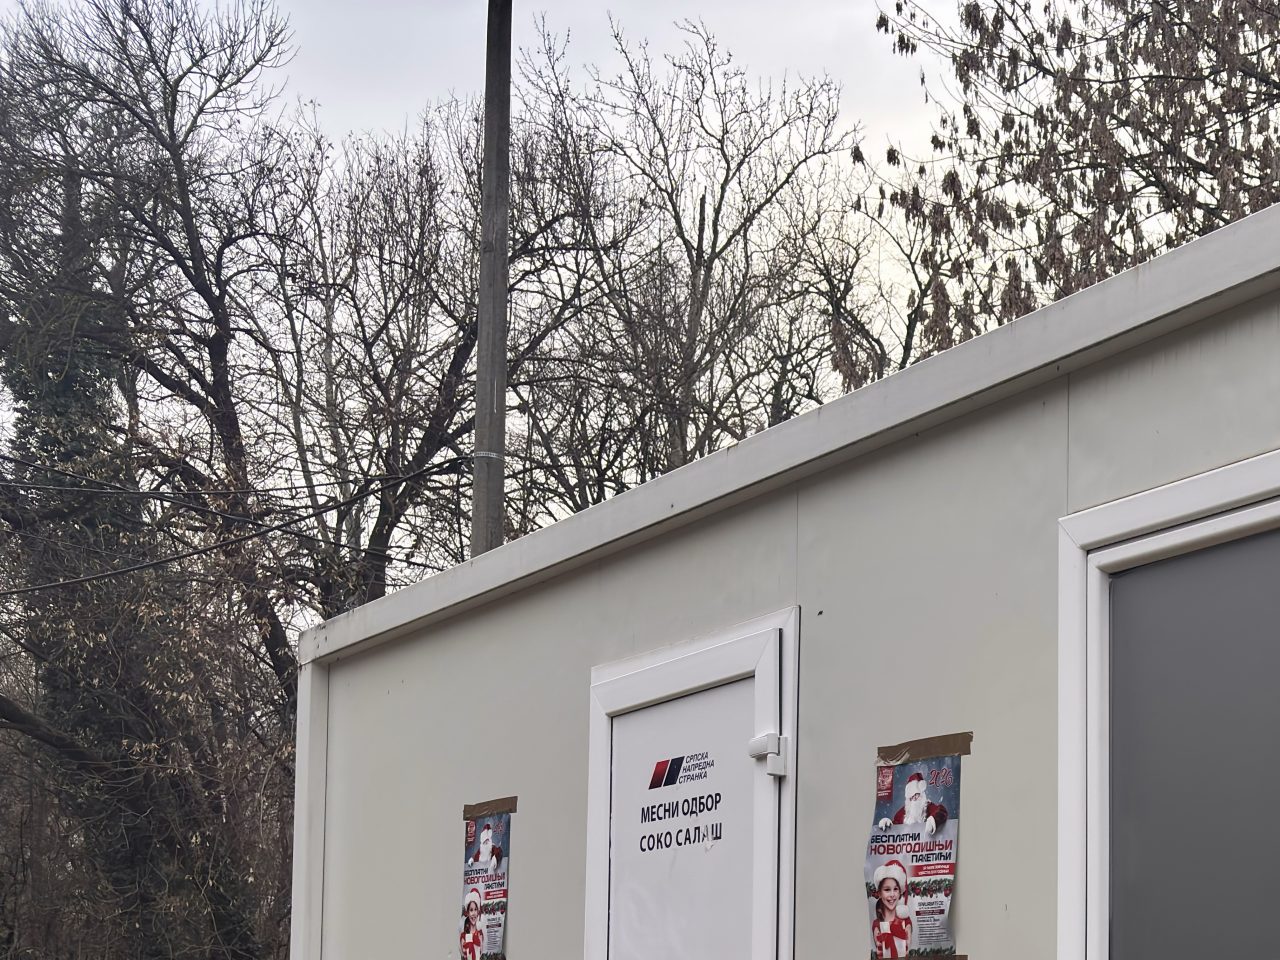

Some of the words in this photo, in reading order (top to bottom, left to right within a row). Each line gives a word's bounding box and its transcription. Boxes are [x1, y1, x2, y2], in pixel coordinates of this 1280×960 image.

[685, 752, 709, 764] СРПСКА
[682, 760, 715, 774] НАПРЕДНА
[678, 771, 708, 784] СТРАНКА
[641, 800, 680, 824] МЕСНИ
[681, 792, 722, 818] ОДБОР
[639, 831, 673, 852] СОКО
[870, 832, 920, 844] БЕСПЛАТНИ
[869, 839, 953, 856] НОВОГОДИШЊИ
[911, 851, 952, 863] ПАКЕТИЋИ
